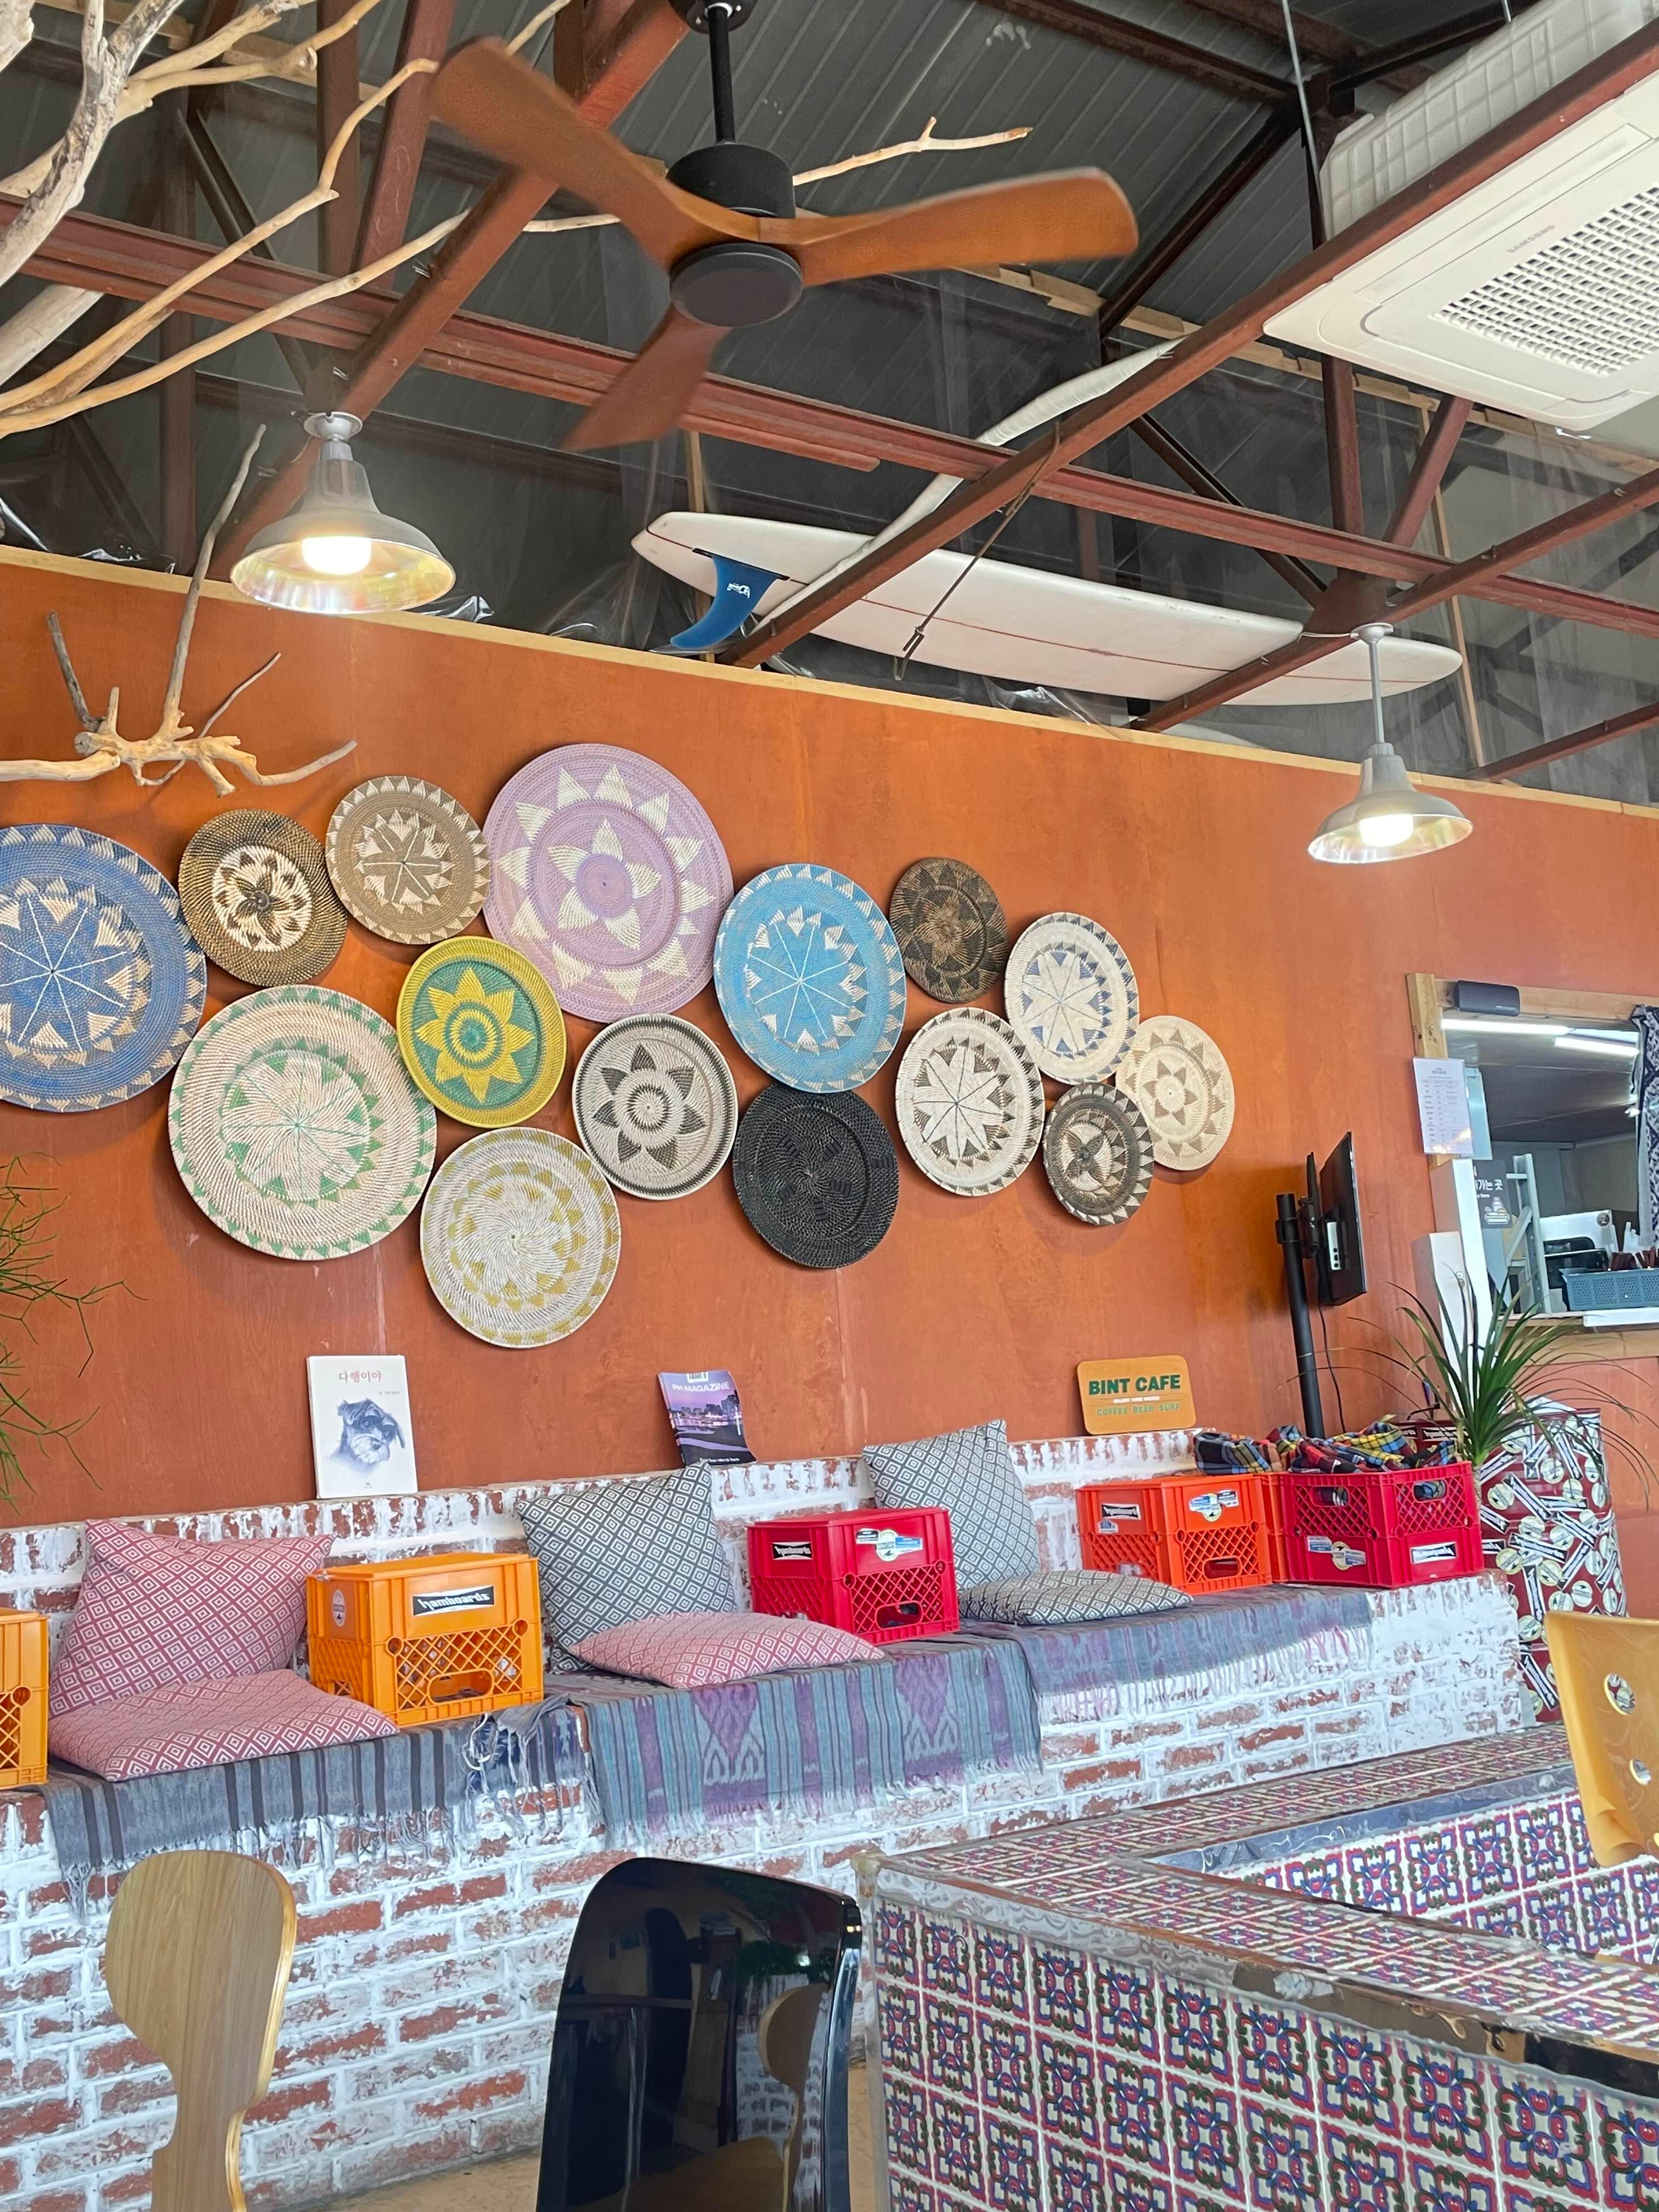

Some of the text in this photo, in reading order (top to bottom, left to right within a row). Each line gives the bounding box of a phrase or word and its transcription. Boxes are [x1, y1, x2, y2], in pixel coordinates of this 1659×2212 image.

[1506, 224, 1555, 253] SAMSUNG
[1475, 1179, 1503, 1190] 가는 곳
[338, 1370, 382, 1383] 다행이야
[684, 1381, 730, 1392] MAGAZINE
[1088, 1374, 1181, 1395] BINT CAFE
[1097, 1403, 1181, 1416] COFFEE BEER SURF
[417, 1592, 490, 1611] hamboards
